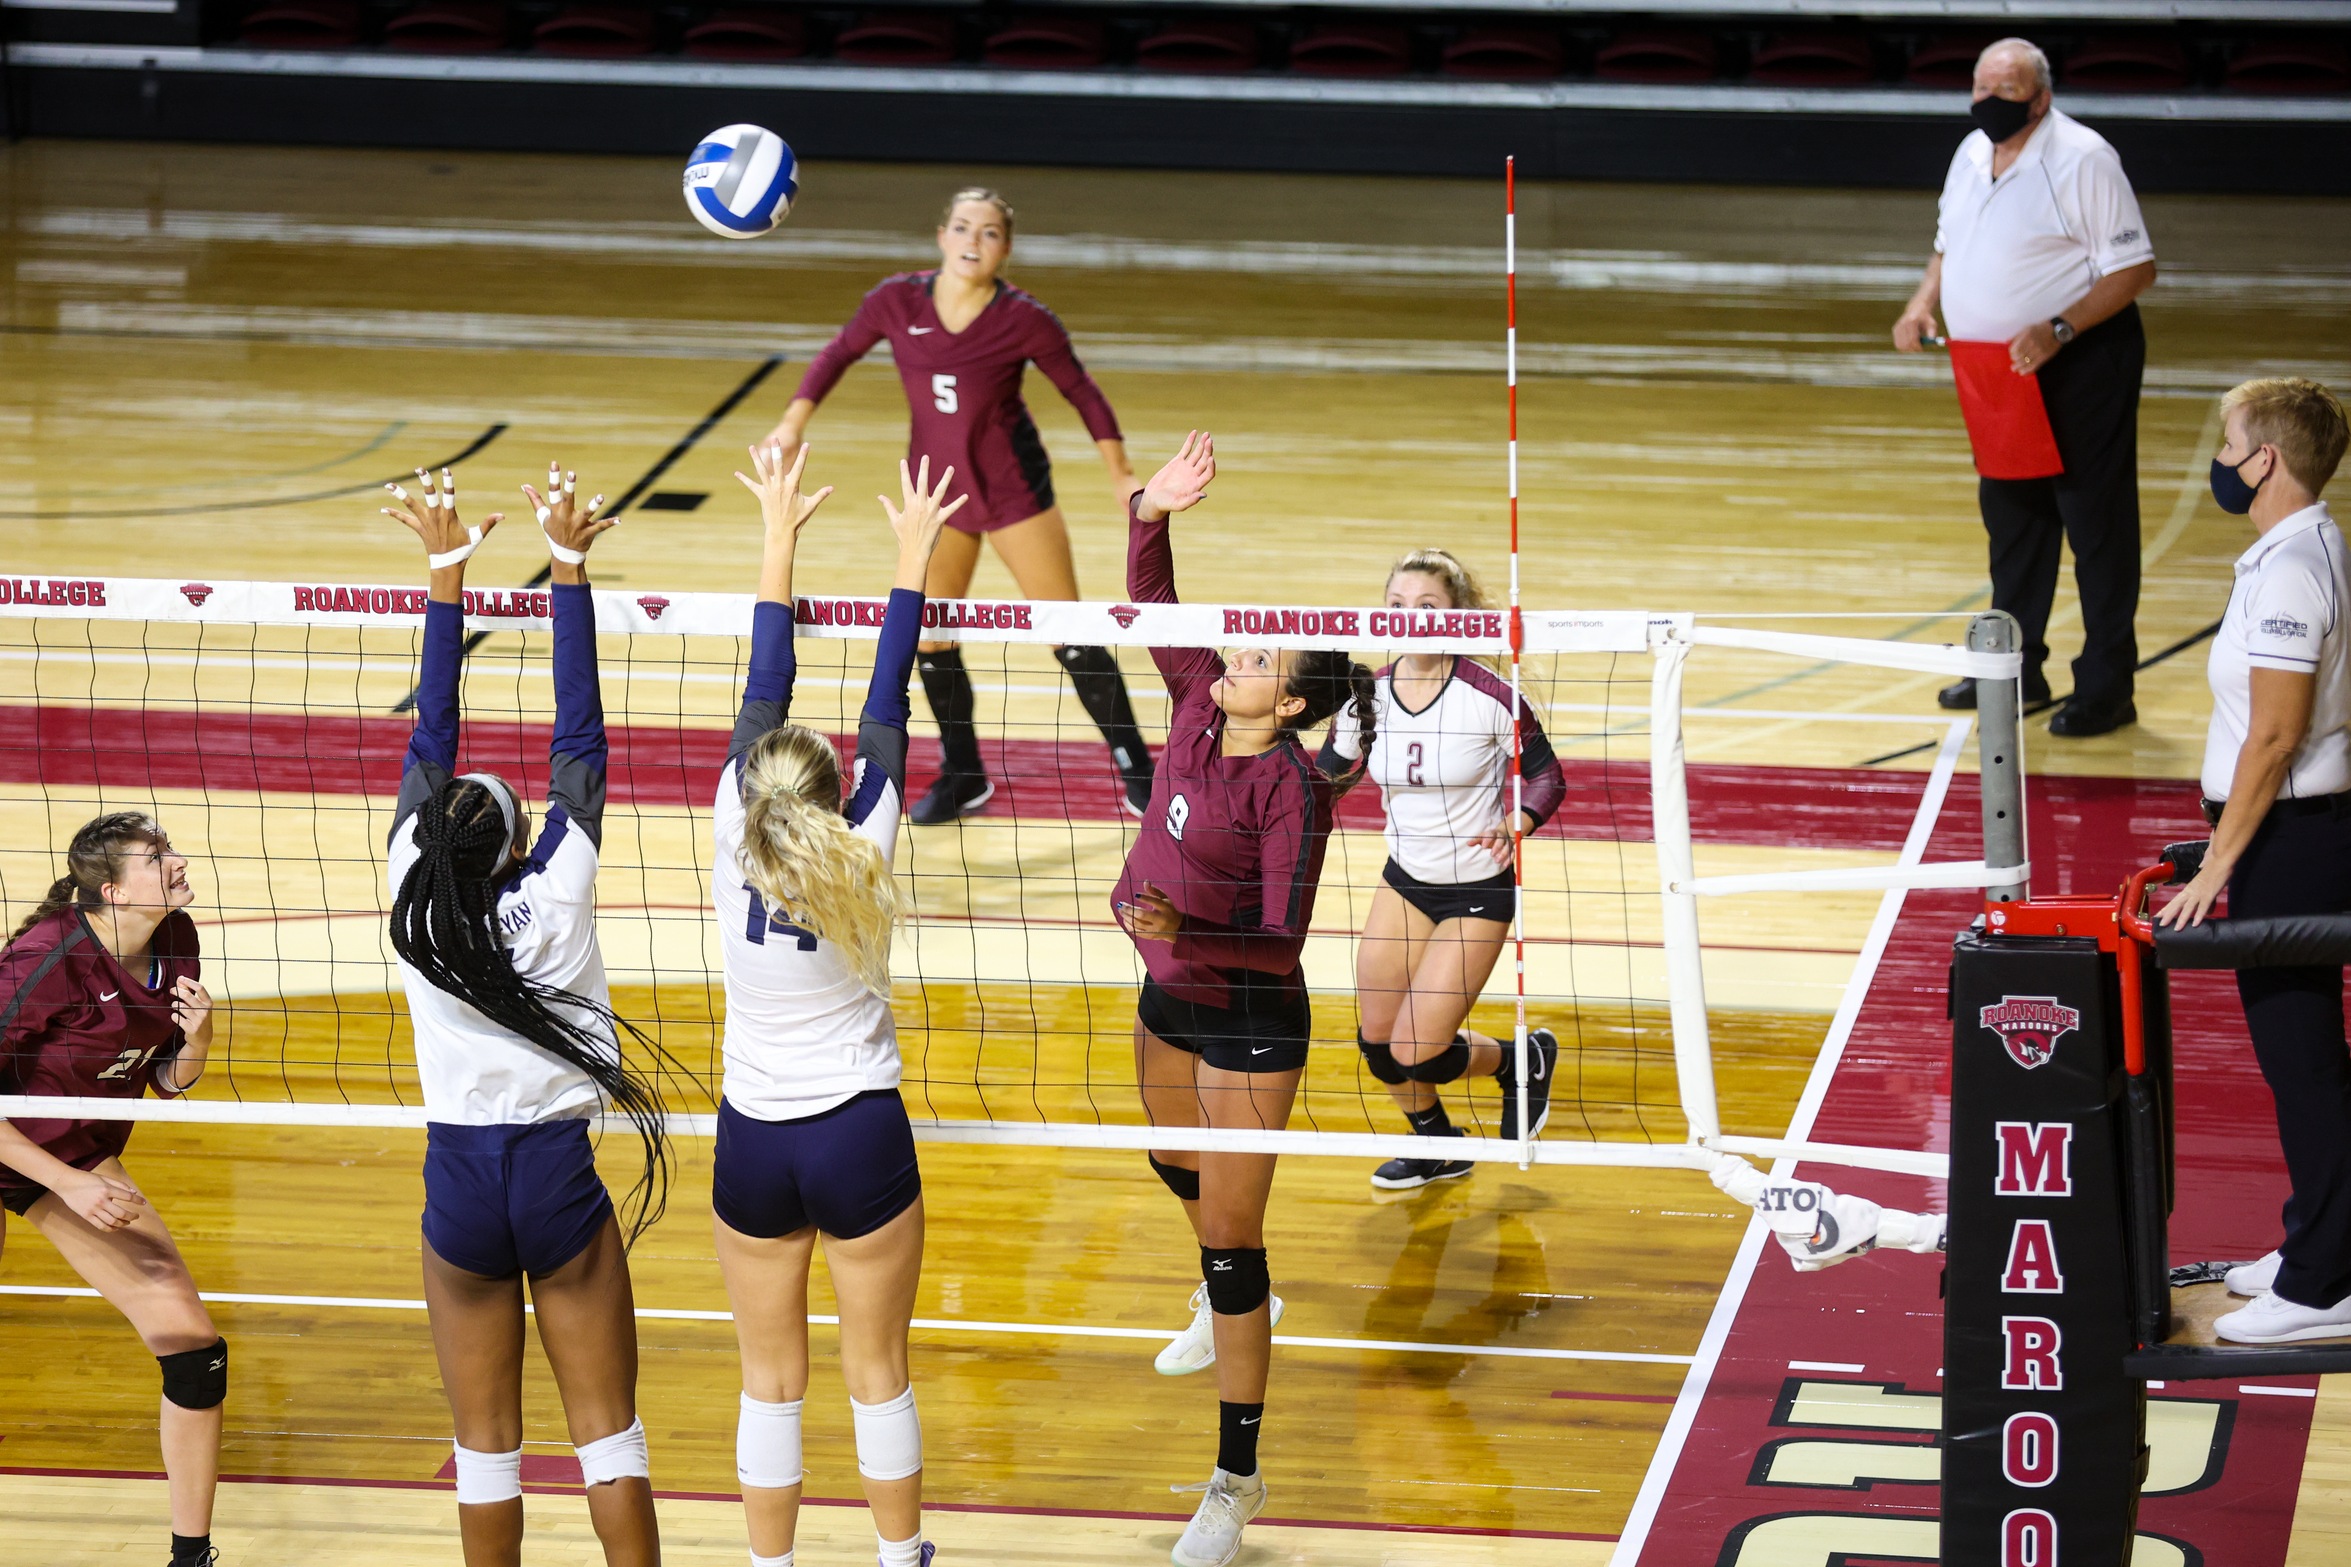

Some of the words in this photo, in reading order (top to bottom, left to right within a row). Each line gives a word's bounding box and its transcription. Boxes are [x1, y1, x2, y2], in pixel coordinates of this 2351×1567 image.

[931, 373, 958, 414] 5
[293, 586, 428, 615] ROANOKE
[462, 590, 555, 618] OLLEG
[794, 599, 888, 627] ANOKE
[921, 602, 1032, 630] OLLEGE
[1223, 608, 1359, 636] ROANOKE
[1369, 611, 1502, 638] COLLEGE
[1548, 620, 1573, 628] sports
[1573, 620, 1604, 628] imports
[2261, 619, 2308, 630] CERTIFIED
[1407, 742, 1424, 787] 2
[1166, 793, 1190, 841] 9
[499, 901, 533, 935] YAN
[1982, 1003, 2077, 1027] ROANOKE
[2001, 1021, 2058, 1032] MAROONS
